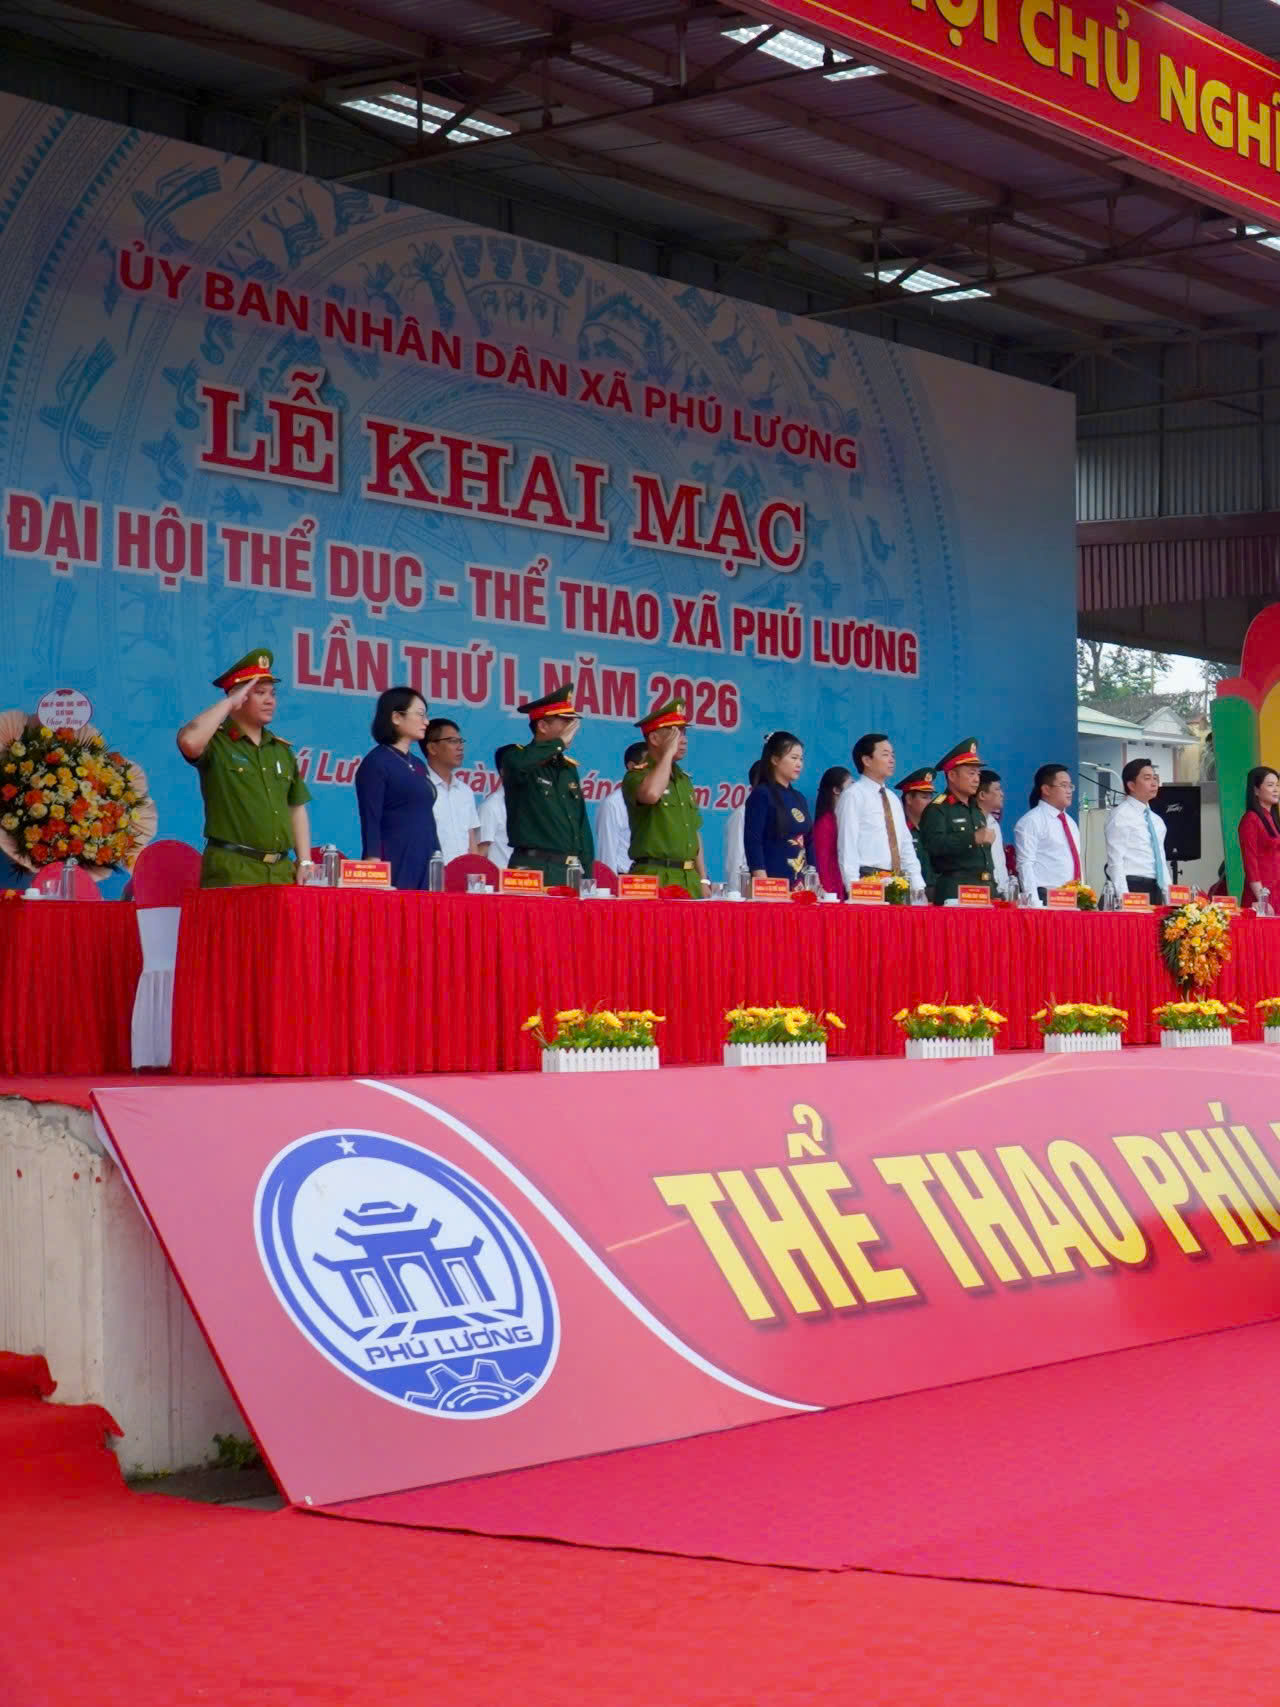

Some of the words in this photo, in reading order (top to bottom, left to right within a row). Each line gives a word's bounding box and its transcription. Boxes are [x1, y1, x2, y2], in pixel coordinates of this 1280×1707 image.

[1019, 0, 1140, 103] CHỦ
[119, 242, 191, 299] ỦY
[204, 271, 309, 331] BAN
[325, 302, 461, 370] NHÂN
[476, 342, 567, 396] DÂN
[579, 368, 633, 412] XÃ
[645, 386, 722, 434] PHÚ
[734, 410, 857, 468] LƯƠNG
[202, 370, 335, 485] LỄ
[365, 420, 605, 534] KHAI
[633, 474, 802, 572] MẠC
[7, 495, 98, 572] ĐẠI
[118, 508, 203, 585] HỘI
[222, 519, 316, 593] THỂ
[330, 545, 423, 614] DỤC
[469, 558, 550, 625] THỂ
[560, 582, 659, 641] THAO
[673, 595, 721, 649] XÃ
[734, 607, 801, 658] PHÚ
[813, 619, 917, 674] LƯƠNG
[298, 620, 390, 692] LẦN
[404, 643, 493, 703] THỨ
[544, 656, 636, 718] NĂM
[650, 676, 738, 728] 2026
[653, 1103, 917, 1321] THỂ
[873, 1140, 1148, 1289] THAO
[365, 1337, 429, 1365] PHÚ
[435, 1325, 534, 1355] LƯƠNG
